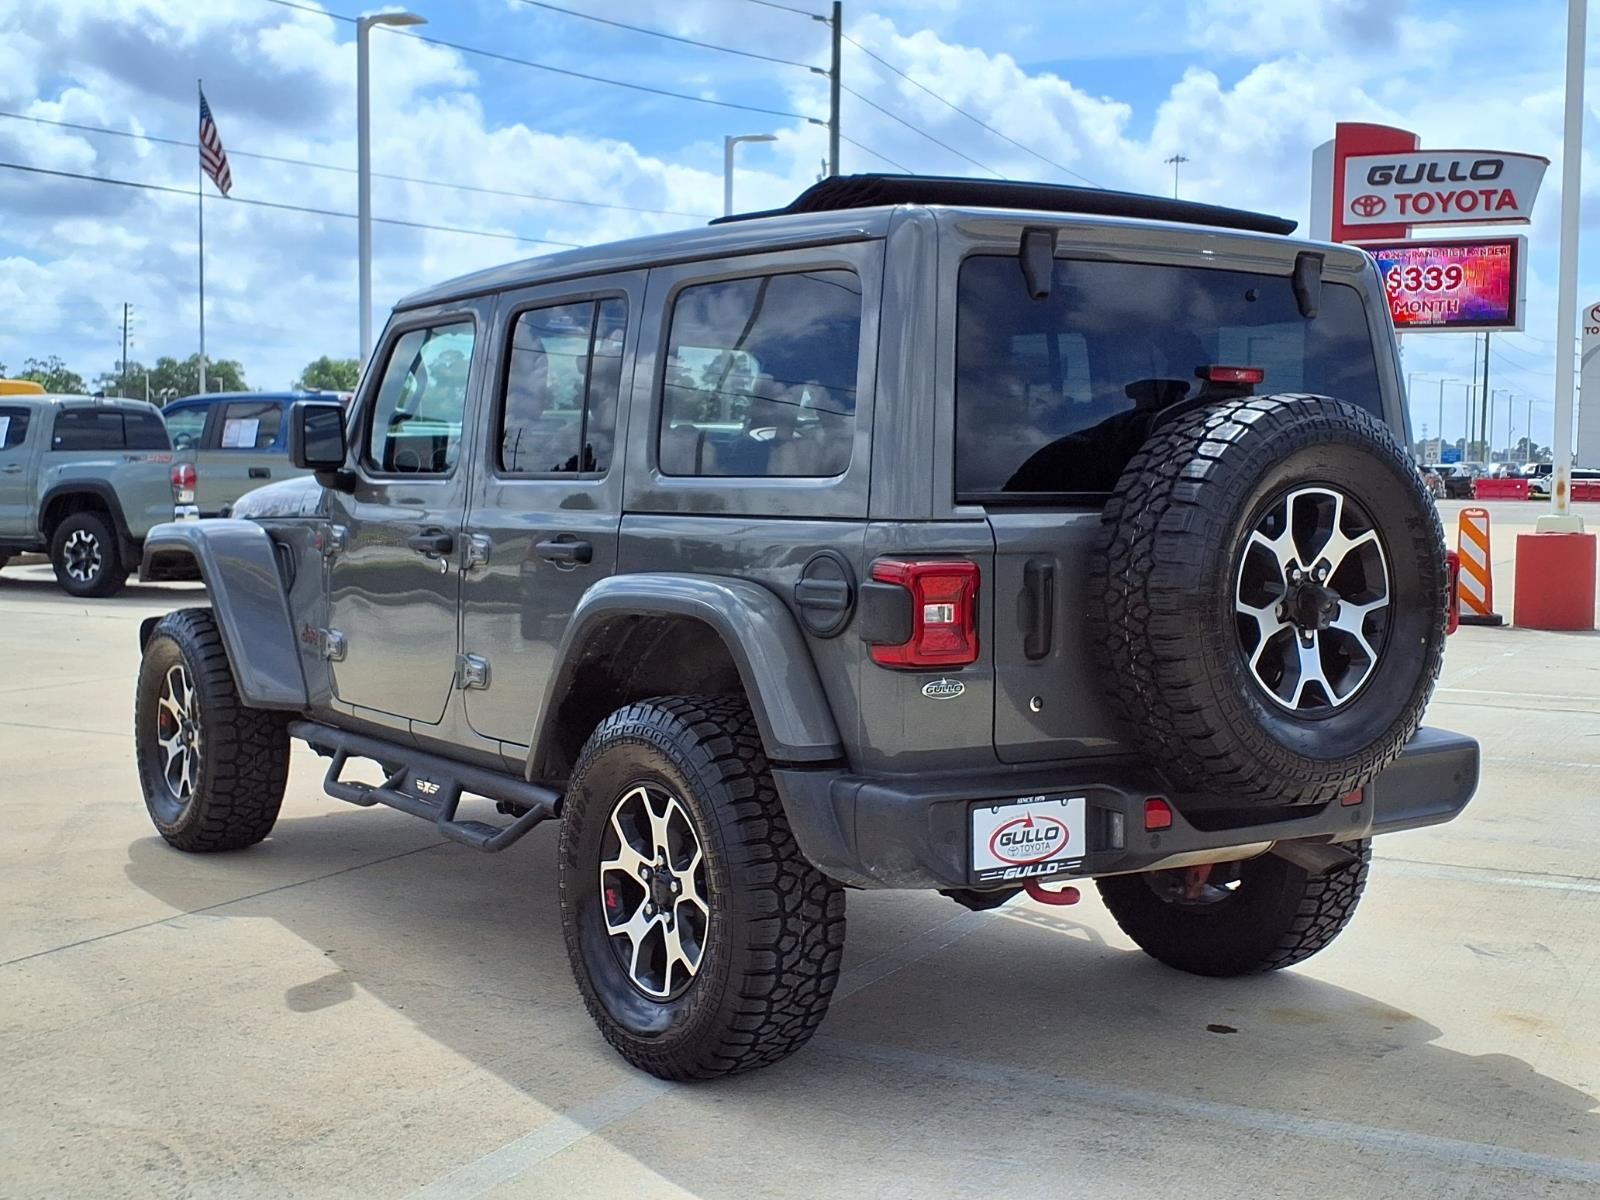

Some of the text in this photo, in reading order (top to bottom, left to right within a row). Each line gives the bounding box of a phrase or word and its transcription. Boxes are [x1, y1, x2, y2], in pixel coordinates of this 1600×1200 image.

[1367, 159, 1504, 186] GULLO
[1394, 188, 1519, 215] TOYOTA
[1387, 264, 1463, 297] $339
[1393, 299, 1460, 315] MONTH
[926, 684, 963, 693] GULLO
[1000, 826, 1060, 847] GULLO
[1020, 842, 1051, 853] TOYOTA
[1003, 862, 1059, 879] GULLO
